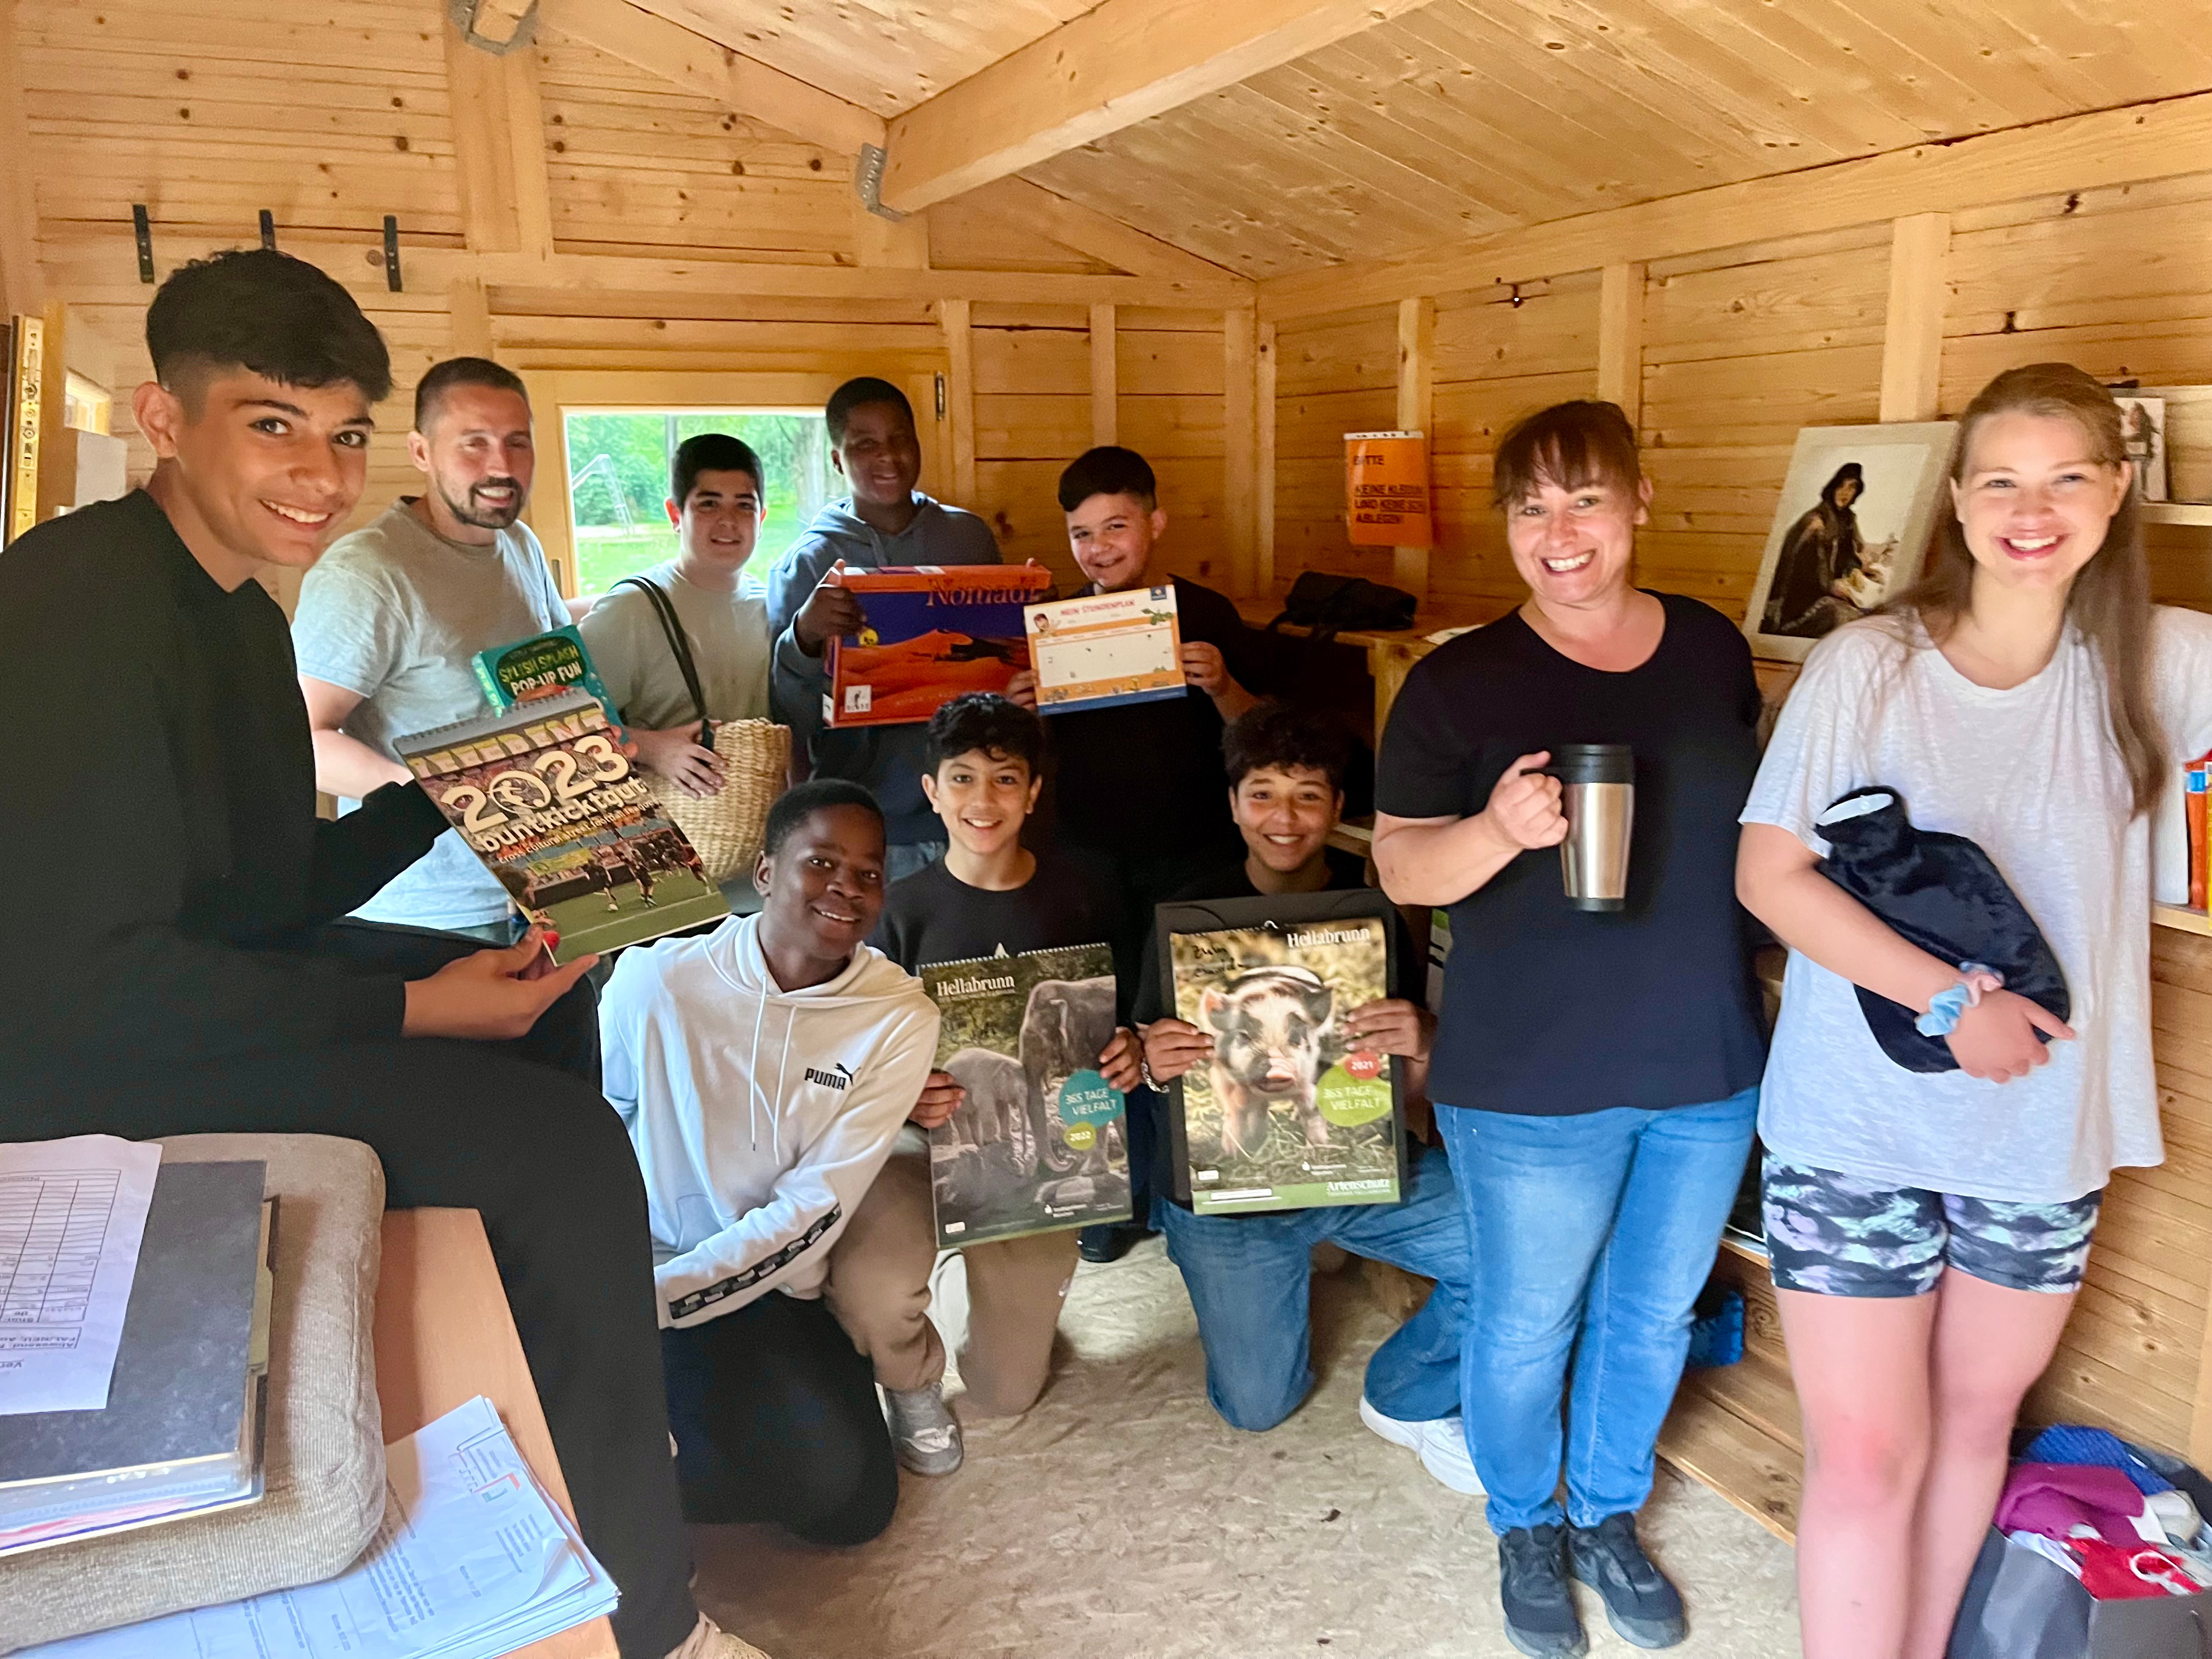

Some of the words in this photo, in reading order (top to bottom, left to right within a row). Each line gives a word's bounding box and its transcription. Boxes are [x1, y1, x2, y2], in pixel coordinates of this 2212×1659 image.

[510, 670, 557, 696] POP-UP
[556, 661, 583, 682] FUN
[476, 776, 650, 853] buntkicktgut
[498, 850, 527, 865] cross
[526, 836, 563, 854] cultural
[562, 823, 591, 841] street
[589, 808, 627, 828] football
[1286, 928, 1370, 948] Hellabrunn
[936, 976, 1015, 996] Hellabrunn
[1351, 1060, 1374, 1070] 2021
[804, 1067, 847, 1091] PUMA
[1084, 1087, 1109, 1101] TAGE
[1330, 1097, 1380, 1110] VIELFALT
[1071, 1099, 1116, 1115] VIELFALT
